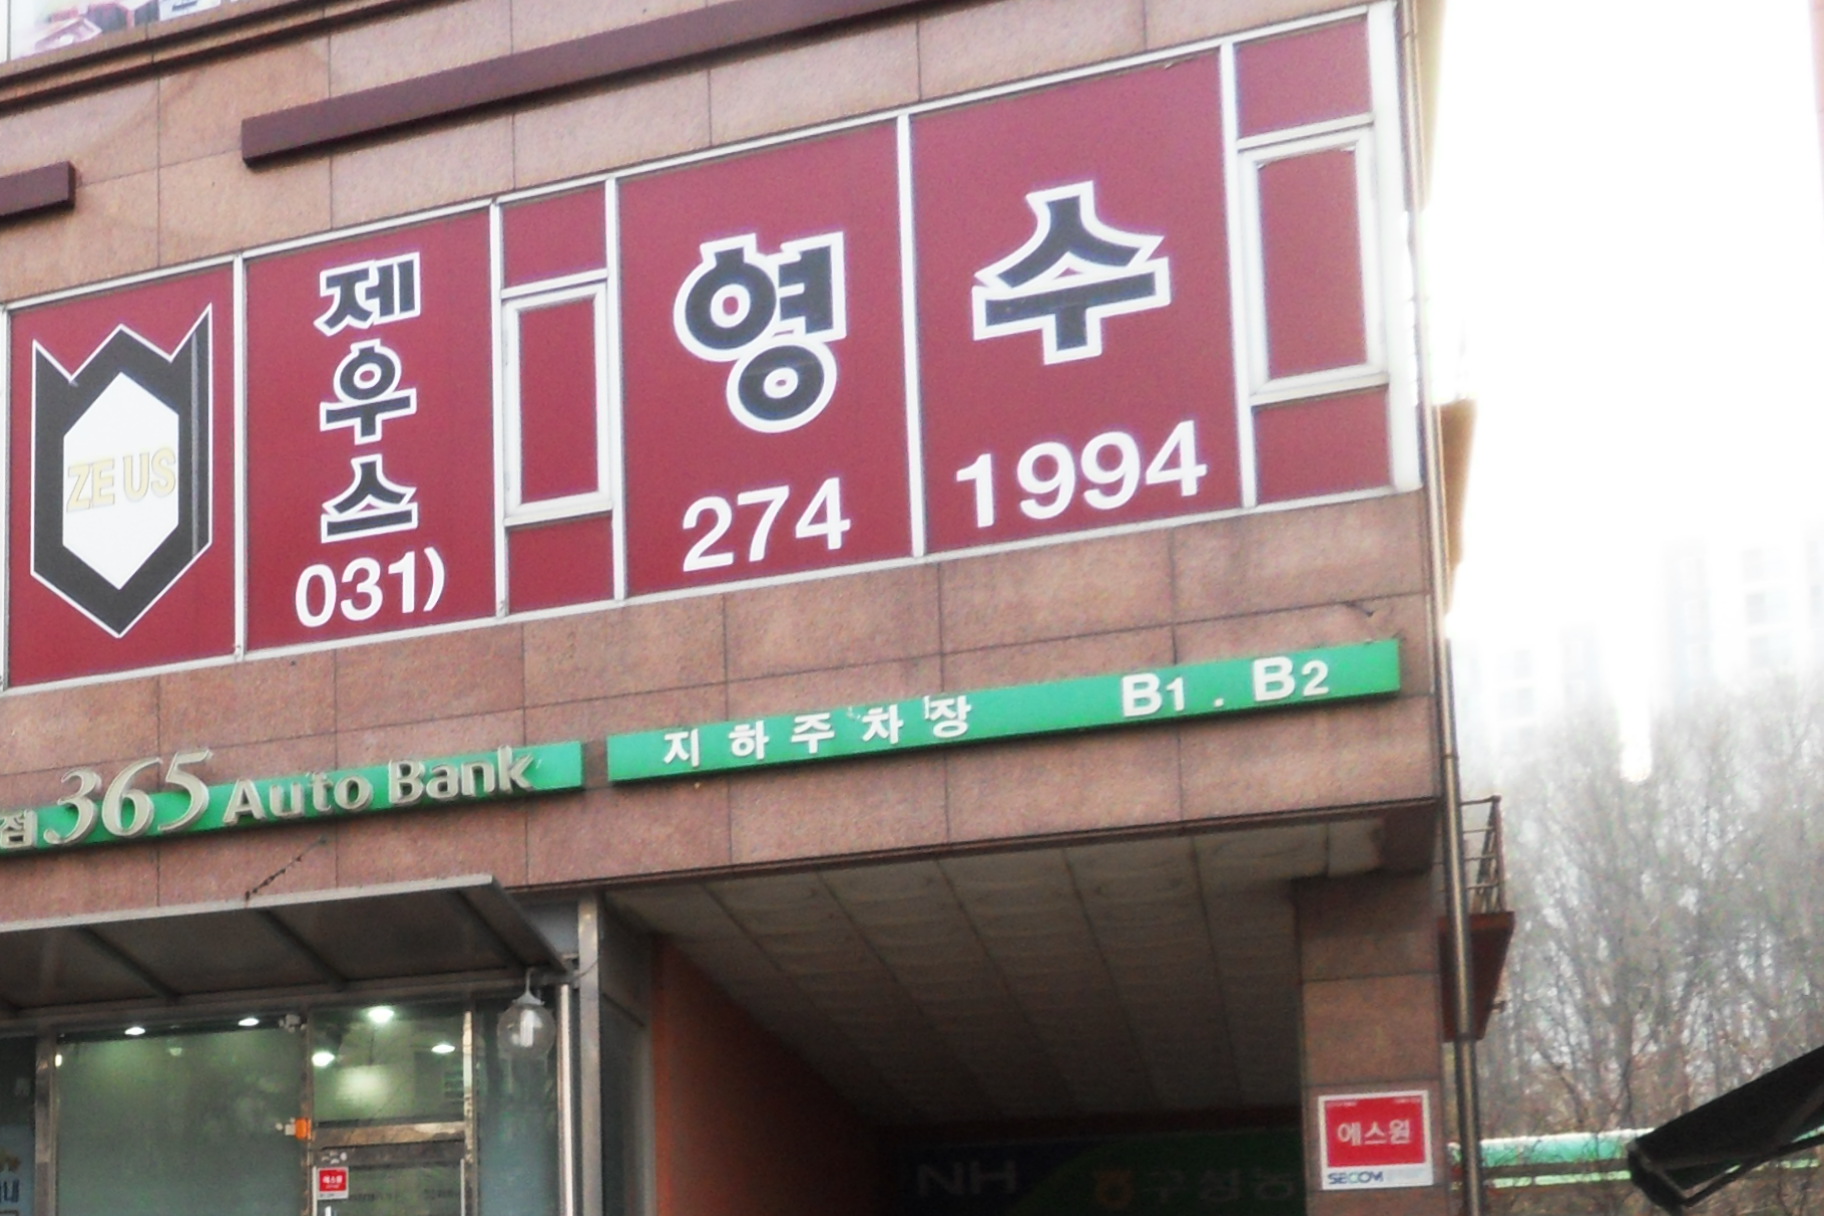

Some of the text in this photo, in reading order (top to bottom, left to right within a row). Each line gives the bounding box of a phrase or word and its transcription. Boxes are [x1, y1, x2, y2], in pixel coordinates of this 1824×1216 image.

[315, 251, 422, 542] 제우스
[66, 446, 177, 513] ZEUS
[293, 420, 1208, 630] 031) 274 1994
[661, 692, 973, 770] 지하주차장
[42, 747, 216, 849] 365
[222, 764, 372, 829] Auto
[387, 745, 533, 805] Bank
[1337, 1118, 1410, 1147] 에스원
[916, 1159, 1018, 1198] NH
[1327, 1170, 1384, 1185] SECOM
